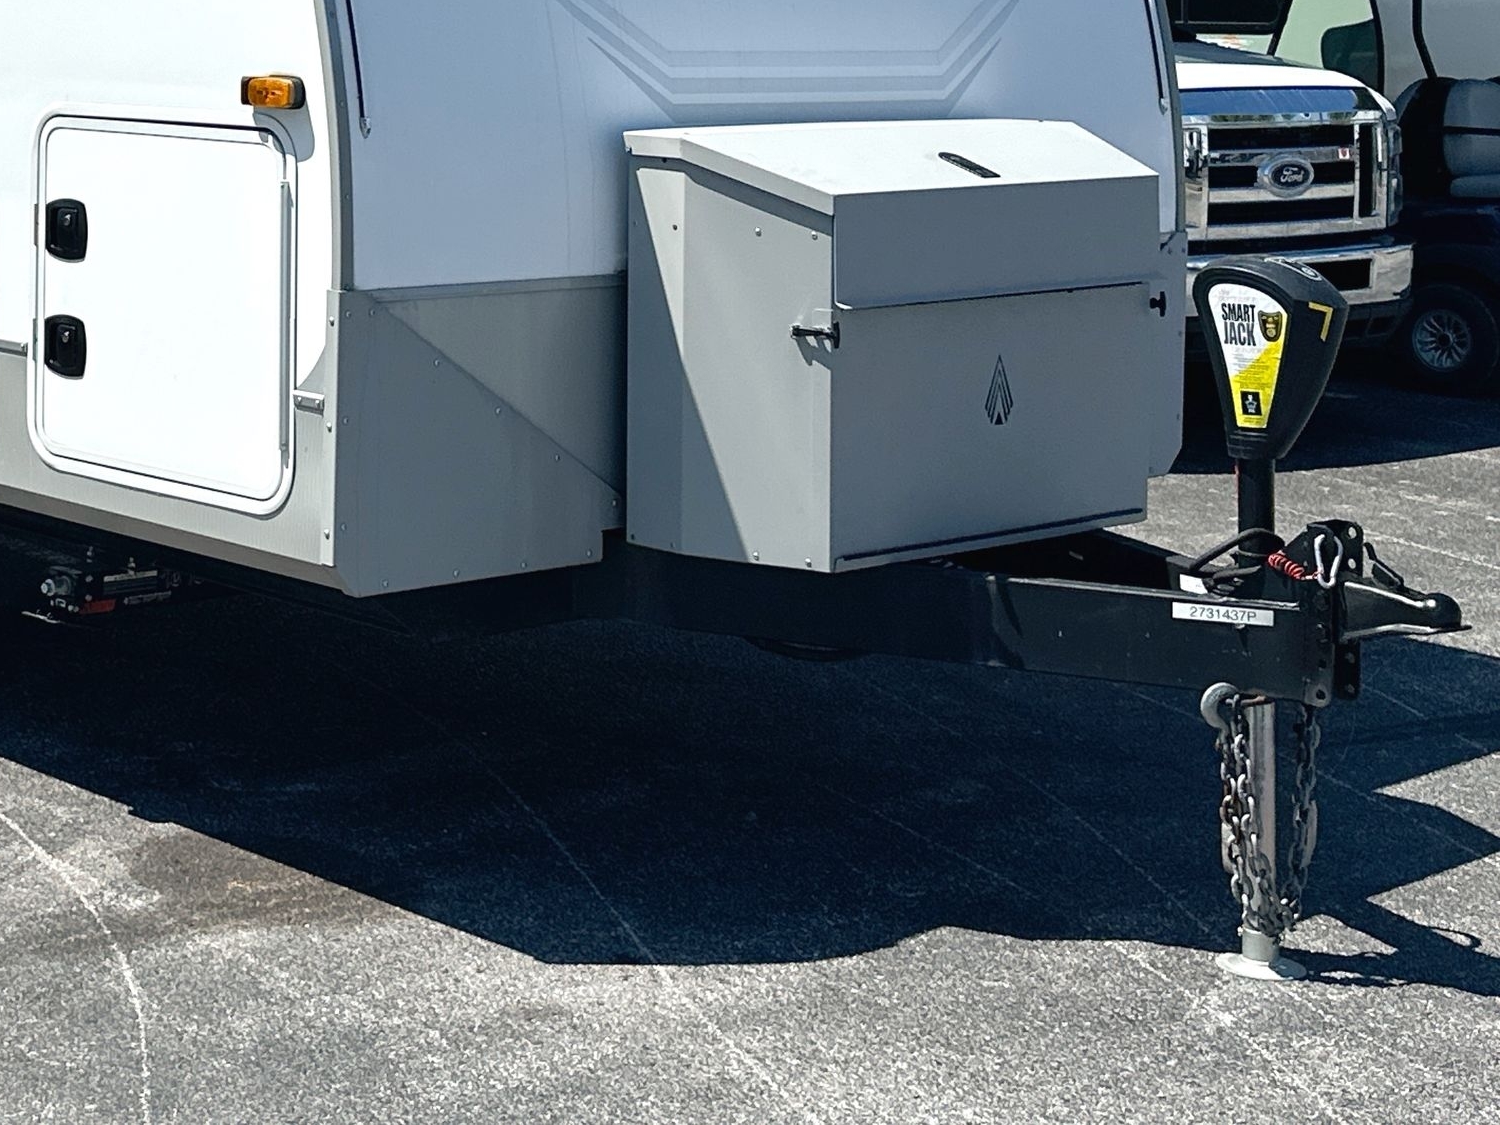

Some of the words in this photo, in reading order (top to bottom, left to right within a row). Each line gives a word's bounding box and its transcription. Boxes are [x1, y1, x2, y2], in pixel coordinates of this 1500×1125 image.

[1280, 166, 1305, 183] Ford
[1221, 302, 1256, 323] SMART
[1223, 321, 1257, 347] JACK
[1189, 605, 1257, 622] 2731437P
